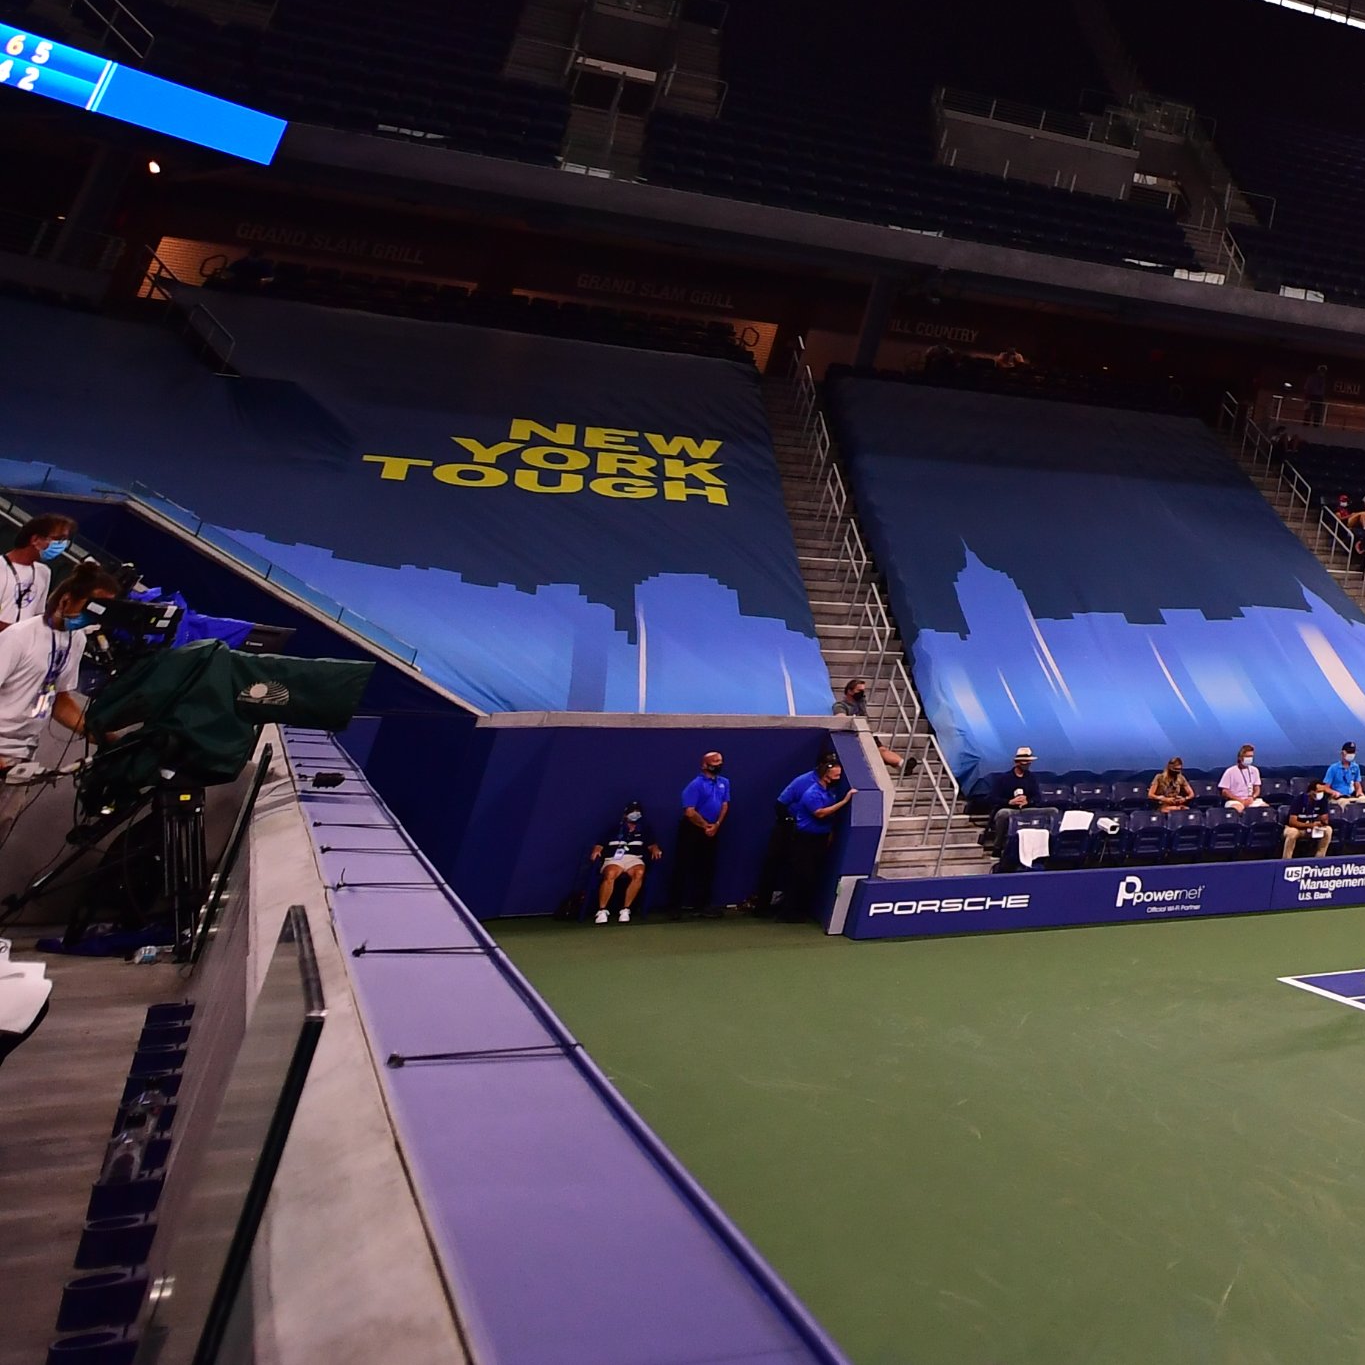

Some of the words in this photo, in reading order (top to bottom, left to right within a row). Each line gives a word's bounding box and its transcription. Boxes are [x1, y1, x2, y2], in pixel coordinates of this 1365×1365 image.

[6, 35, 26, 55] 6
[31, 41, 53, 64] 5
[18, 66, 40, 91] 2
[236, 222, 307, 246] GRAND
[311, 234, 368, 256] SLAM
[371, 242, 425, 264] GRILL
[577, 273, 636, 295] GRAND
[640, 283, 688, 302] SLAM
[690, 289, 735, 309] GRILL
[889, 318, 913, 334] ILL
[915, 321, 980, 343] COUNTRY
[508, 418, 724, 459] NEW
[450, 436, 728, 486] YORK
[362, 454, 729, 506] TOUGH
[1301, 864, 1342, 878] Private
[869, 894, 1031, 918] PORSCHE
[1132, 885, 1203, 906] powernet
[1298, 892, 1312, 901] U.S.
[1313, 890, 1332, 900] Bank
